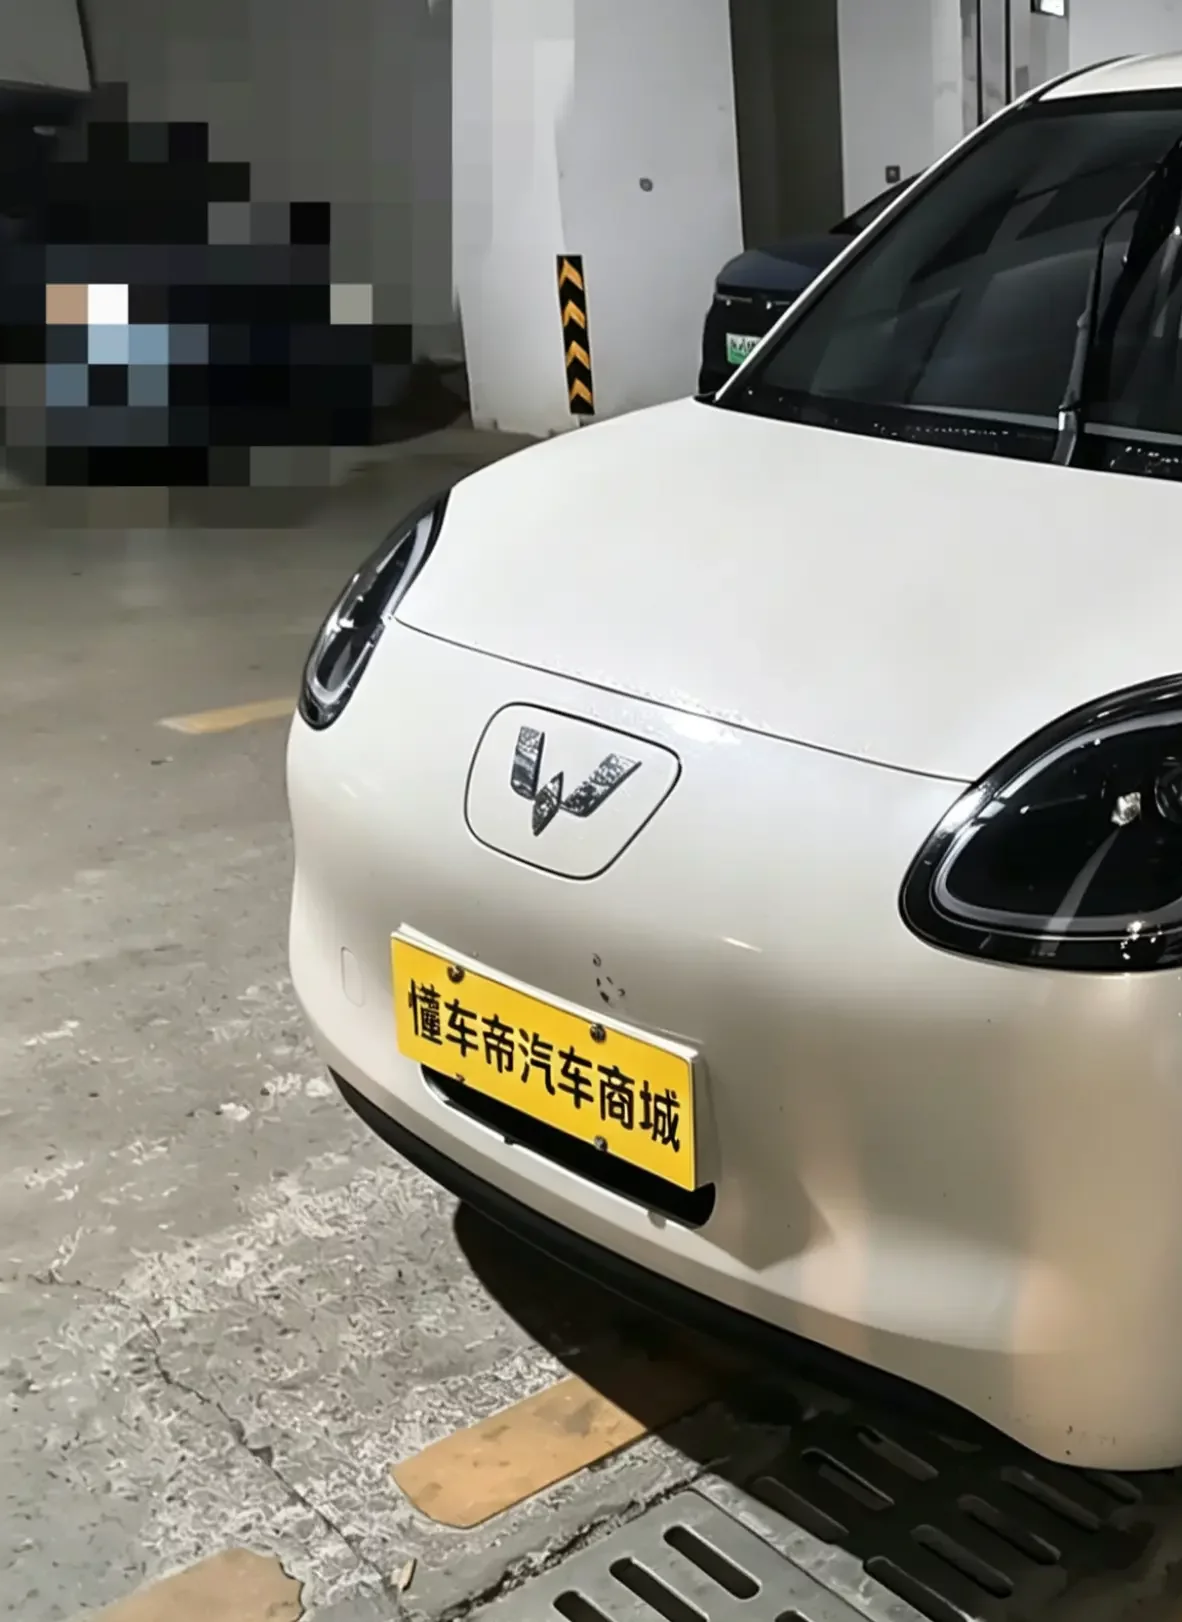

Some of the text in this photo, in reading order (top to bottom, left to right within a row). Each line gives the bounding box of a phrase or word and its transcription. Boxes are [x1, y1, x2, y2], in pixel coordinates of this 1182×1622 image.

[408, 978, 681, 1152] 懂车帝汽车商城
